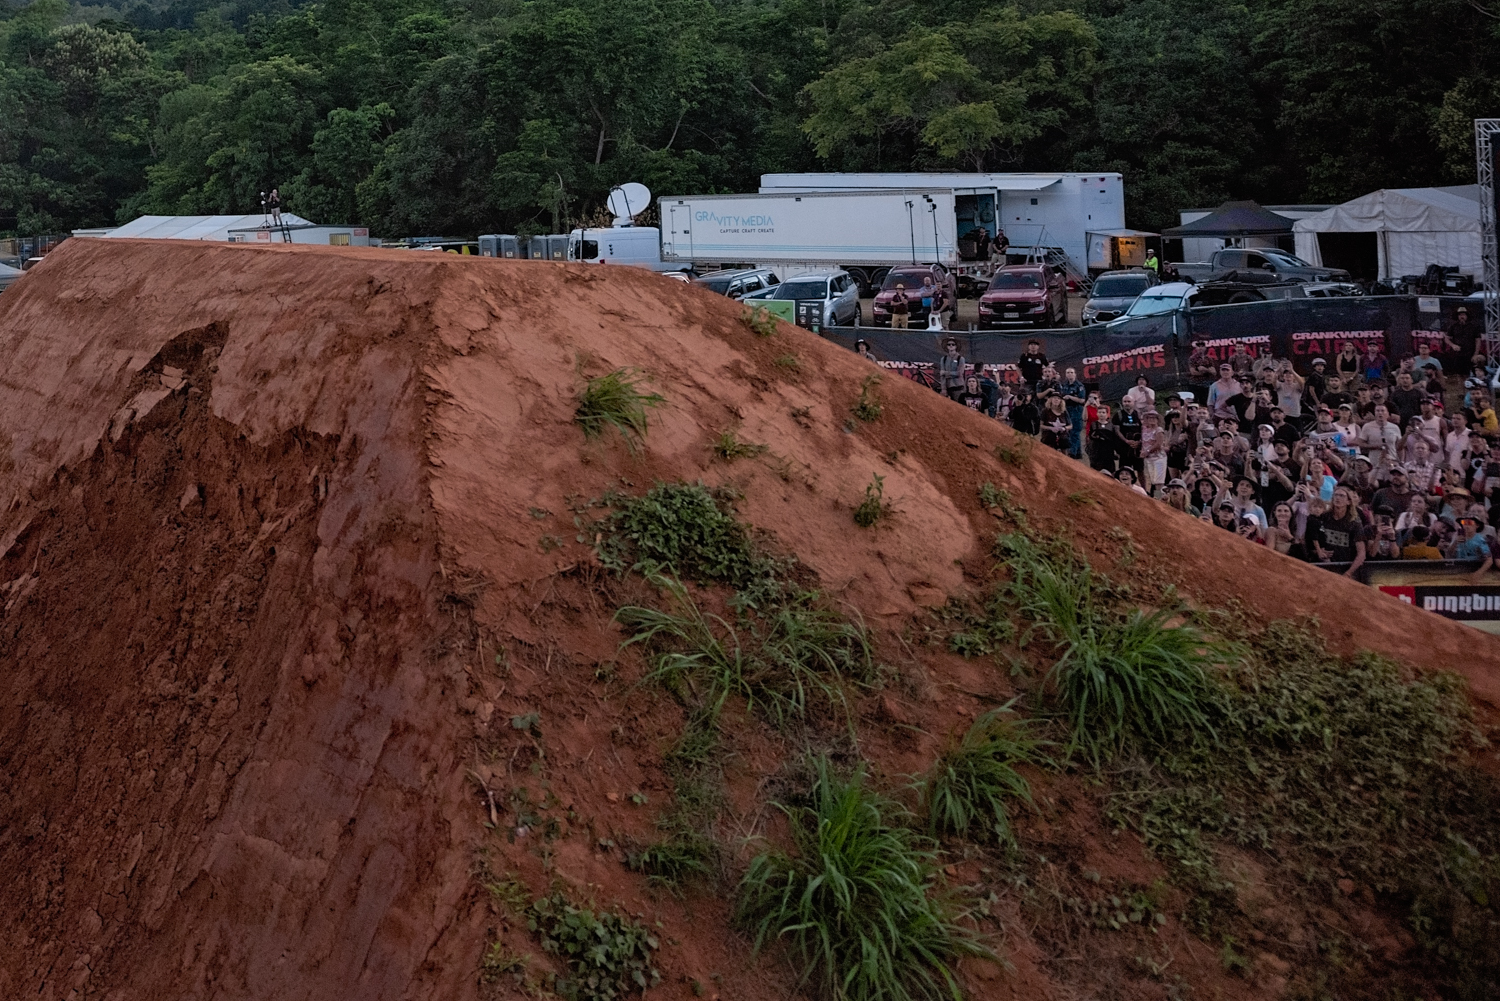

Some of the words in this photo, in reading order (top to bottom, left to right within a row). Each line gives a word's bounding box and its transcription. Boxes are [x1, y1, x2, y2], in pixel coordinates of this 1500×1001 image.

[695, 211, 740, 226] GRAVITY
[742, 215, 774, 226] MEDIA
[1292, 330, 1384, 340] CRANKWORX
[1082, 344, 1165, 365] CRANKWORX
[1084, 352, 1165, 379] CAIRNS
